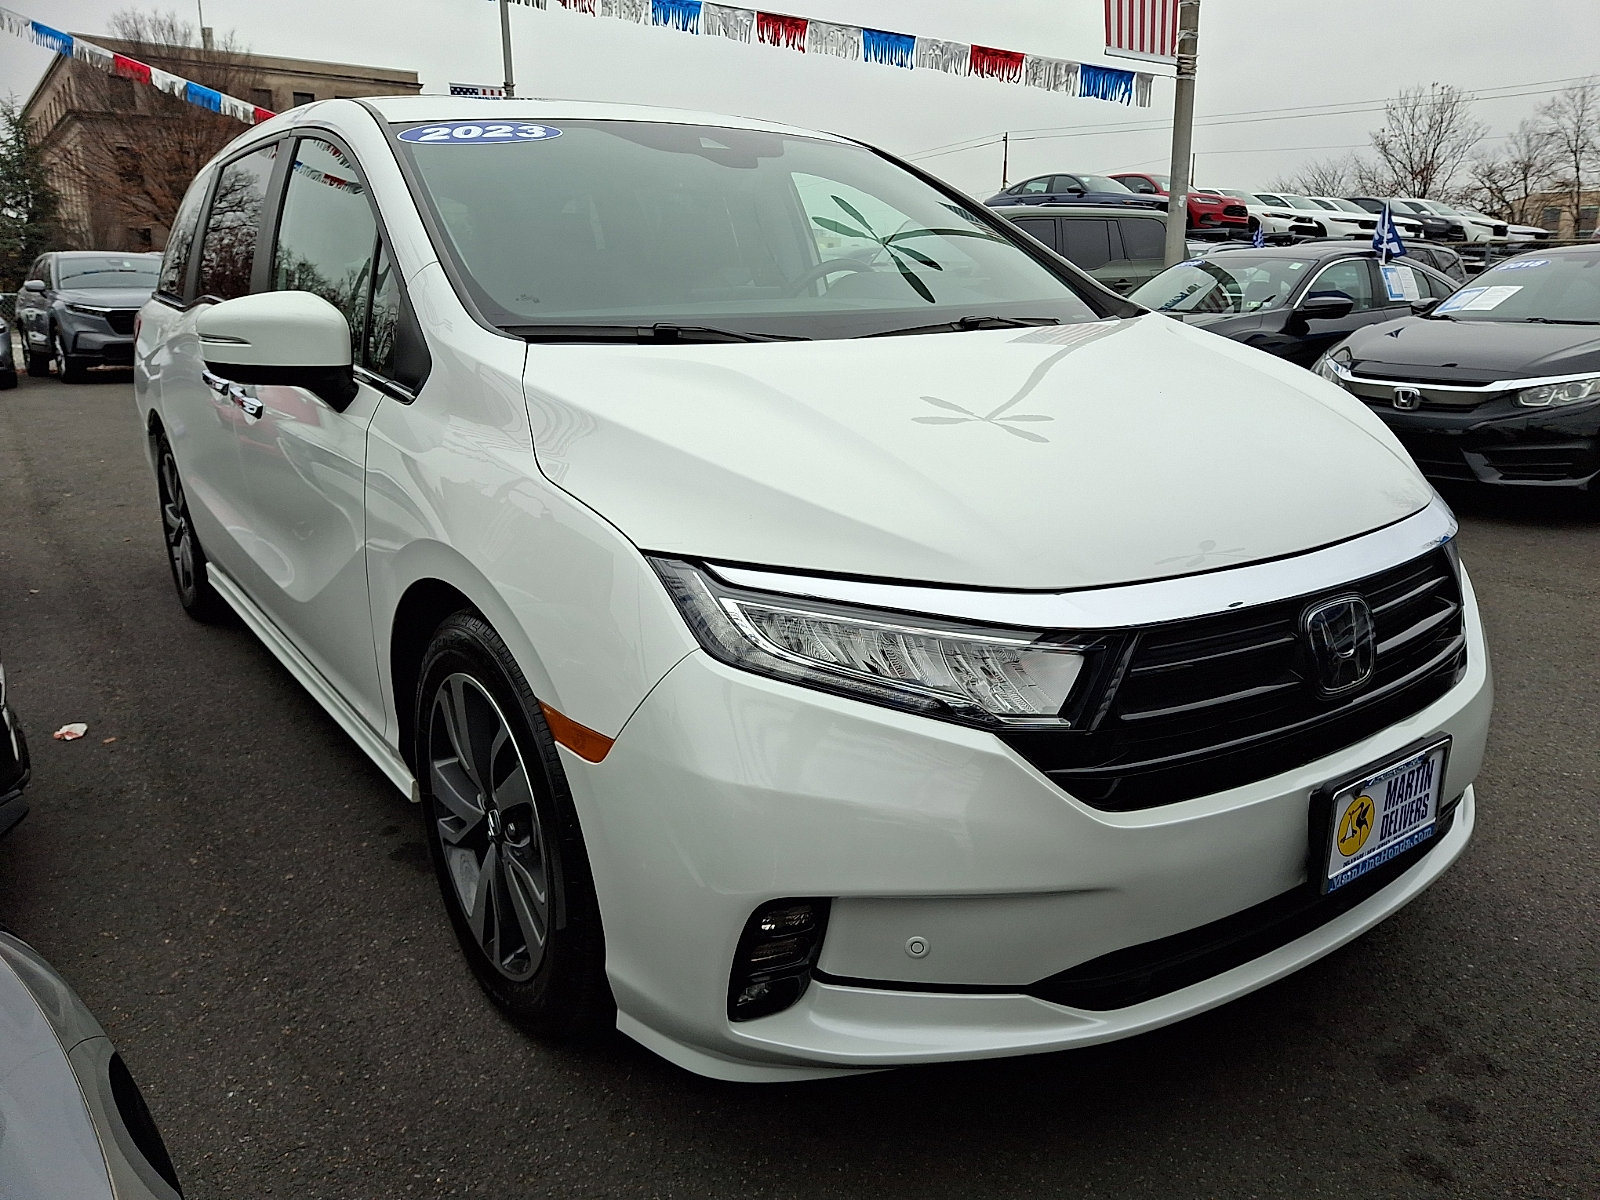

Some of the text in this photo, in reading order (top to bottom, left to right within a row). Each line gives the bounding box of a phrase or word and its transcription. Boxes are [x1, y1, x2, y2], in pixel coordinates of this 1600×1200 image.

[418, 125, 547, 141] 2023
[1384, 759, 1436, 812] MARTIN
[1380, 793, 1430, 841] DELIVERS
